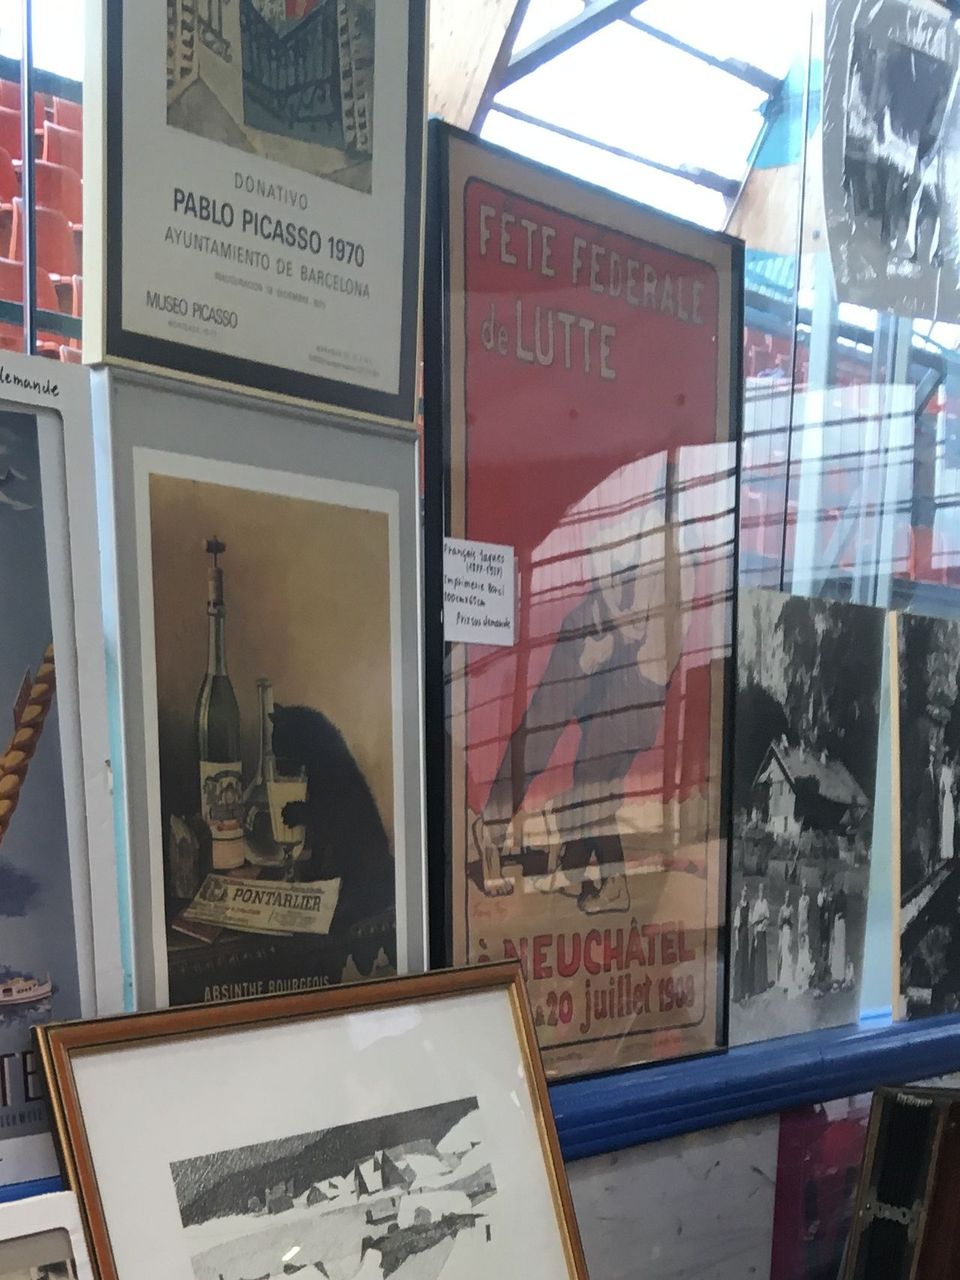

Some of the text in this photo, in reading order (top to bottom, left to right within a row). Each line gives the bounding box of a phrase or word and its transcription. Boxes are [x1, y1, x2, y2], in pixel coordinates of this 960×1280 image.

[234, 172, 308, 211] DONATIVO
[173, 187, 365, 268] PABLO PICASSO 1970
[164, 226, 271, 271] AYUNTAMIENTO
[276, 258, 293, 278] DE
[300, 265, 371, 300] BARCELONA
[145, 289, 188, 317] MUSEO
[192, 301, 239, 330] PICASSO
[481, 299, 617, 380] de LUTTE
[232, 888, 321, 912] PONTARLIER
[502, 916, 696, 984] NEUCHÂTEL
[204, 975, 330, 1002] ABSINTHE BOURGEOIS
[546, 990, 573, 1027] 20
[580, 973, 653, 1034] juillet
